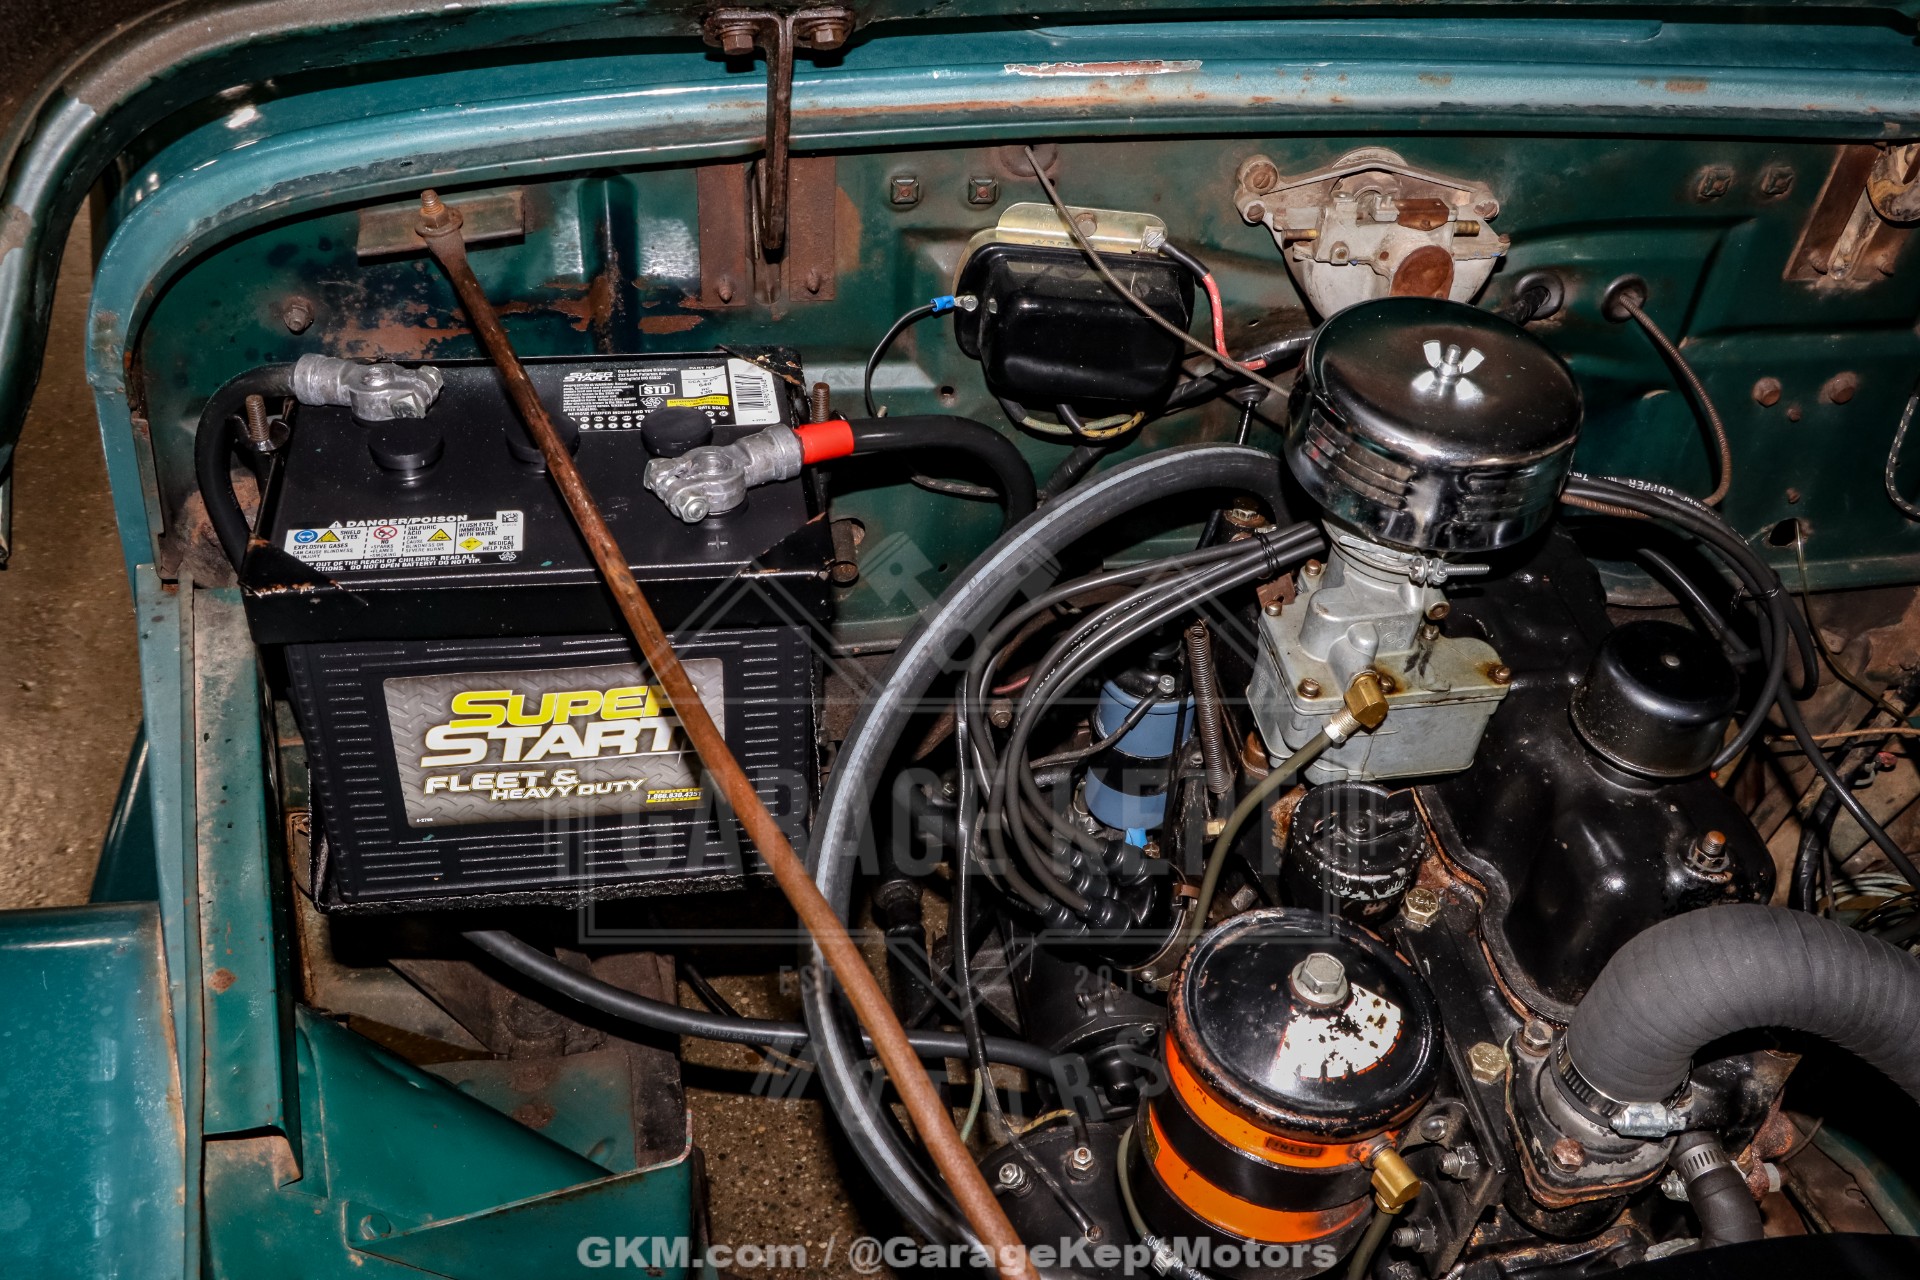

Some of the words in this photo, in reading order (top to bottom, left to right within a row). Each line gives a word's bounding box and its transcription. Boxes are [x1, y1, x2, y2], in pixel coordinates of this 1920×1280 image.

[644, 385, 671, 395] STD
[346, 515, 468, 529] DANGER/POISON
[402, 560, 436, 568] BATTERY!
[420, 715, 685, 768] START
[424, 770, 546, 795] FLEET
[552, 768, 580, 786] &
[489, 785, 578, 802] HEAVY
[577, 778, 648, 797] DUTY
